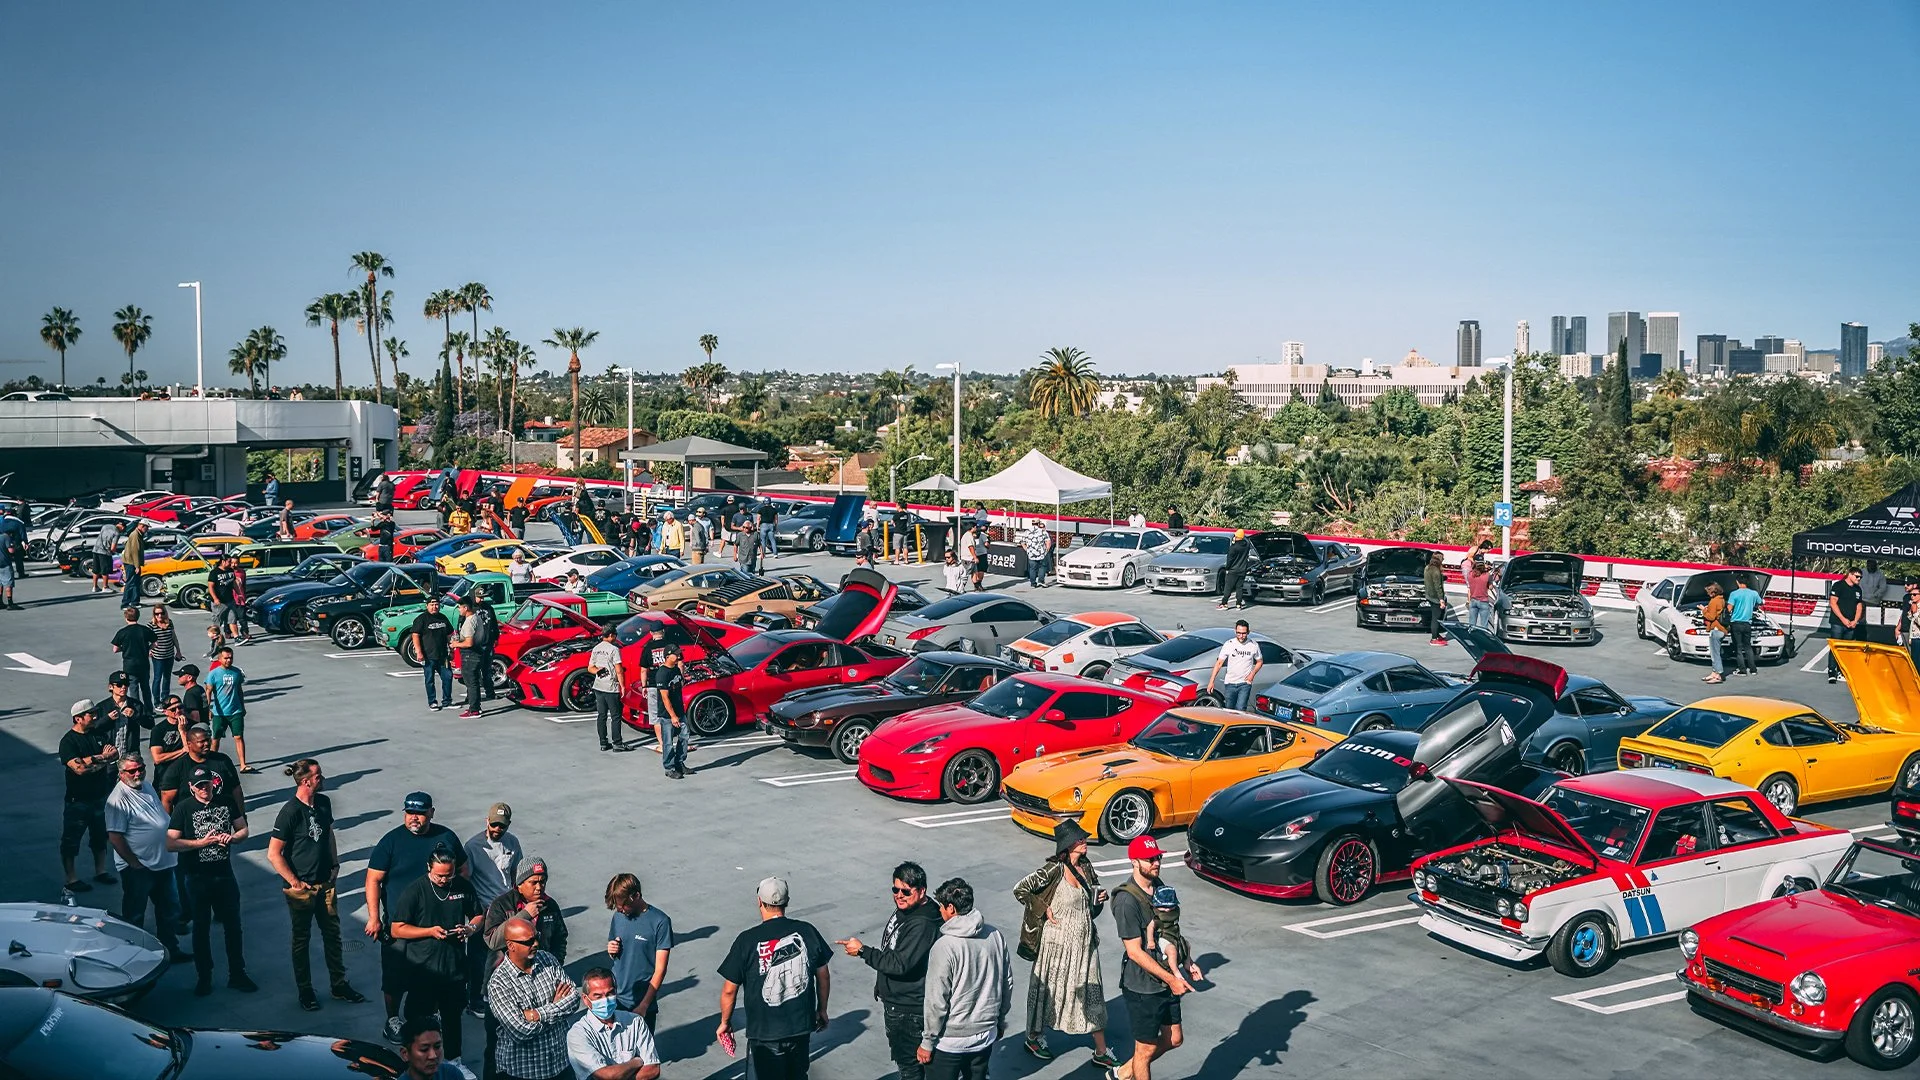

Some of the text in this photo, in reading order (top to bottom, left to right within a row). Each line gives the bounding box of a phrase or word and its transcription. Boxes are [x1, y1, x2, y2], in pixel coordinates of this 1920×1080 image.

[1496, 508, 1510, 520] P3
[1847, 519, 1920, 527] TOPRA
[1339, 743, 1412, 767] nismo
[1622, 888, 1651, 898] DATSUN
